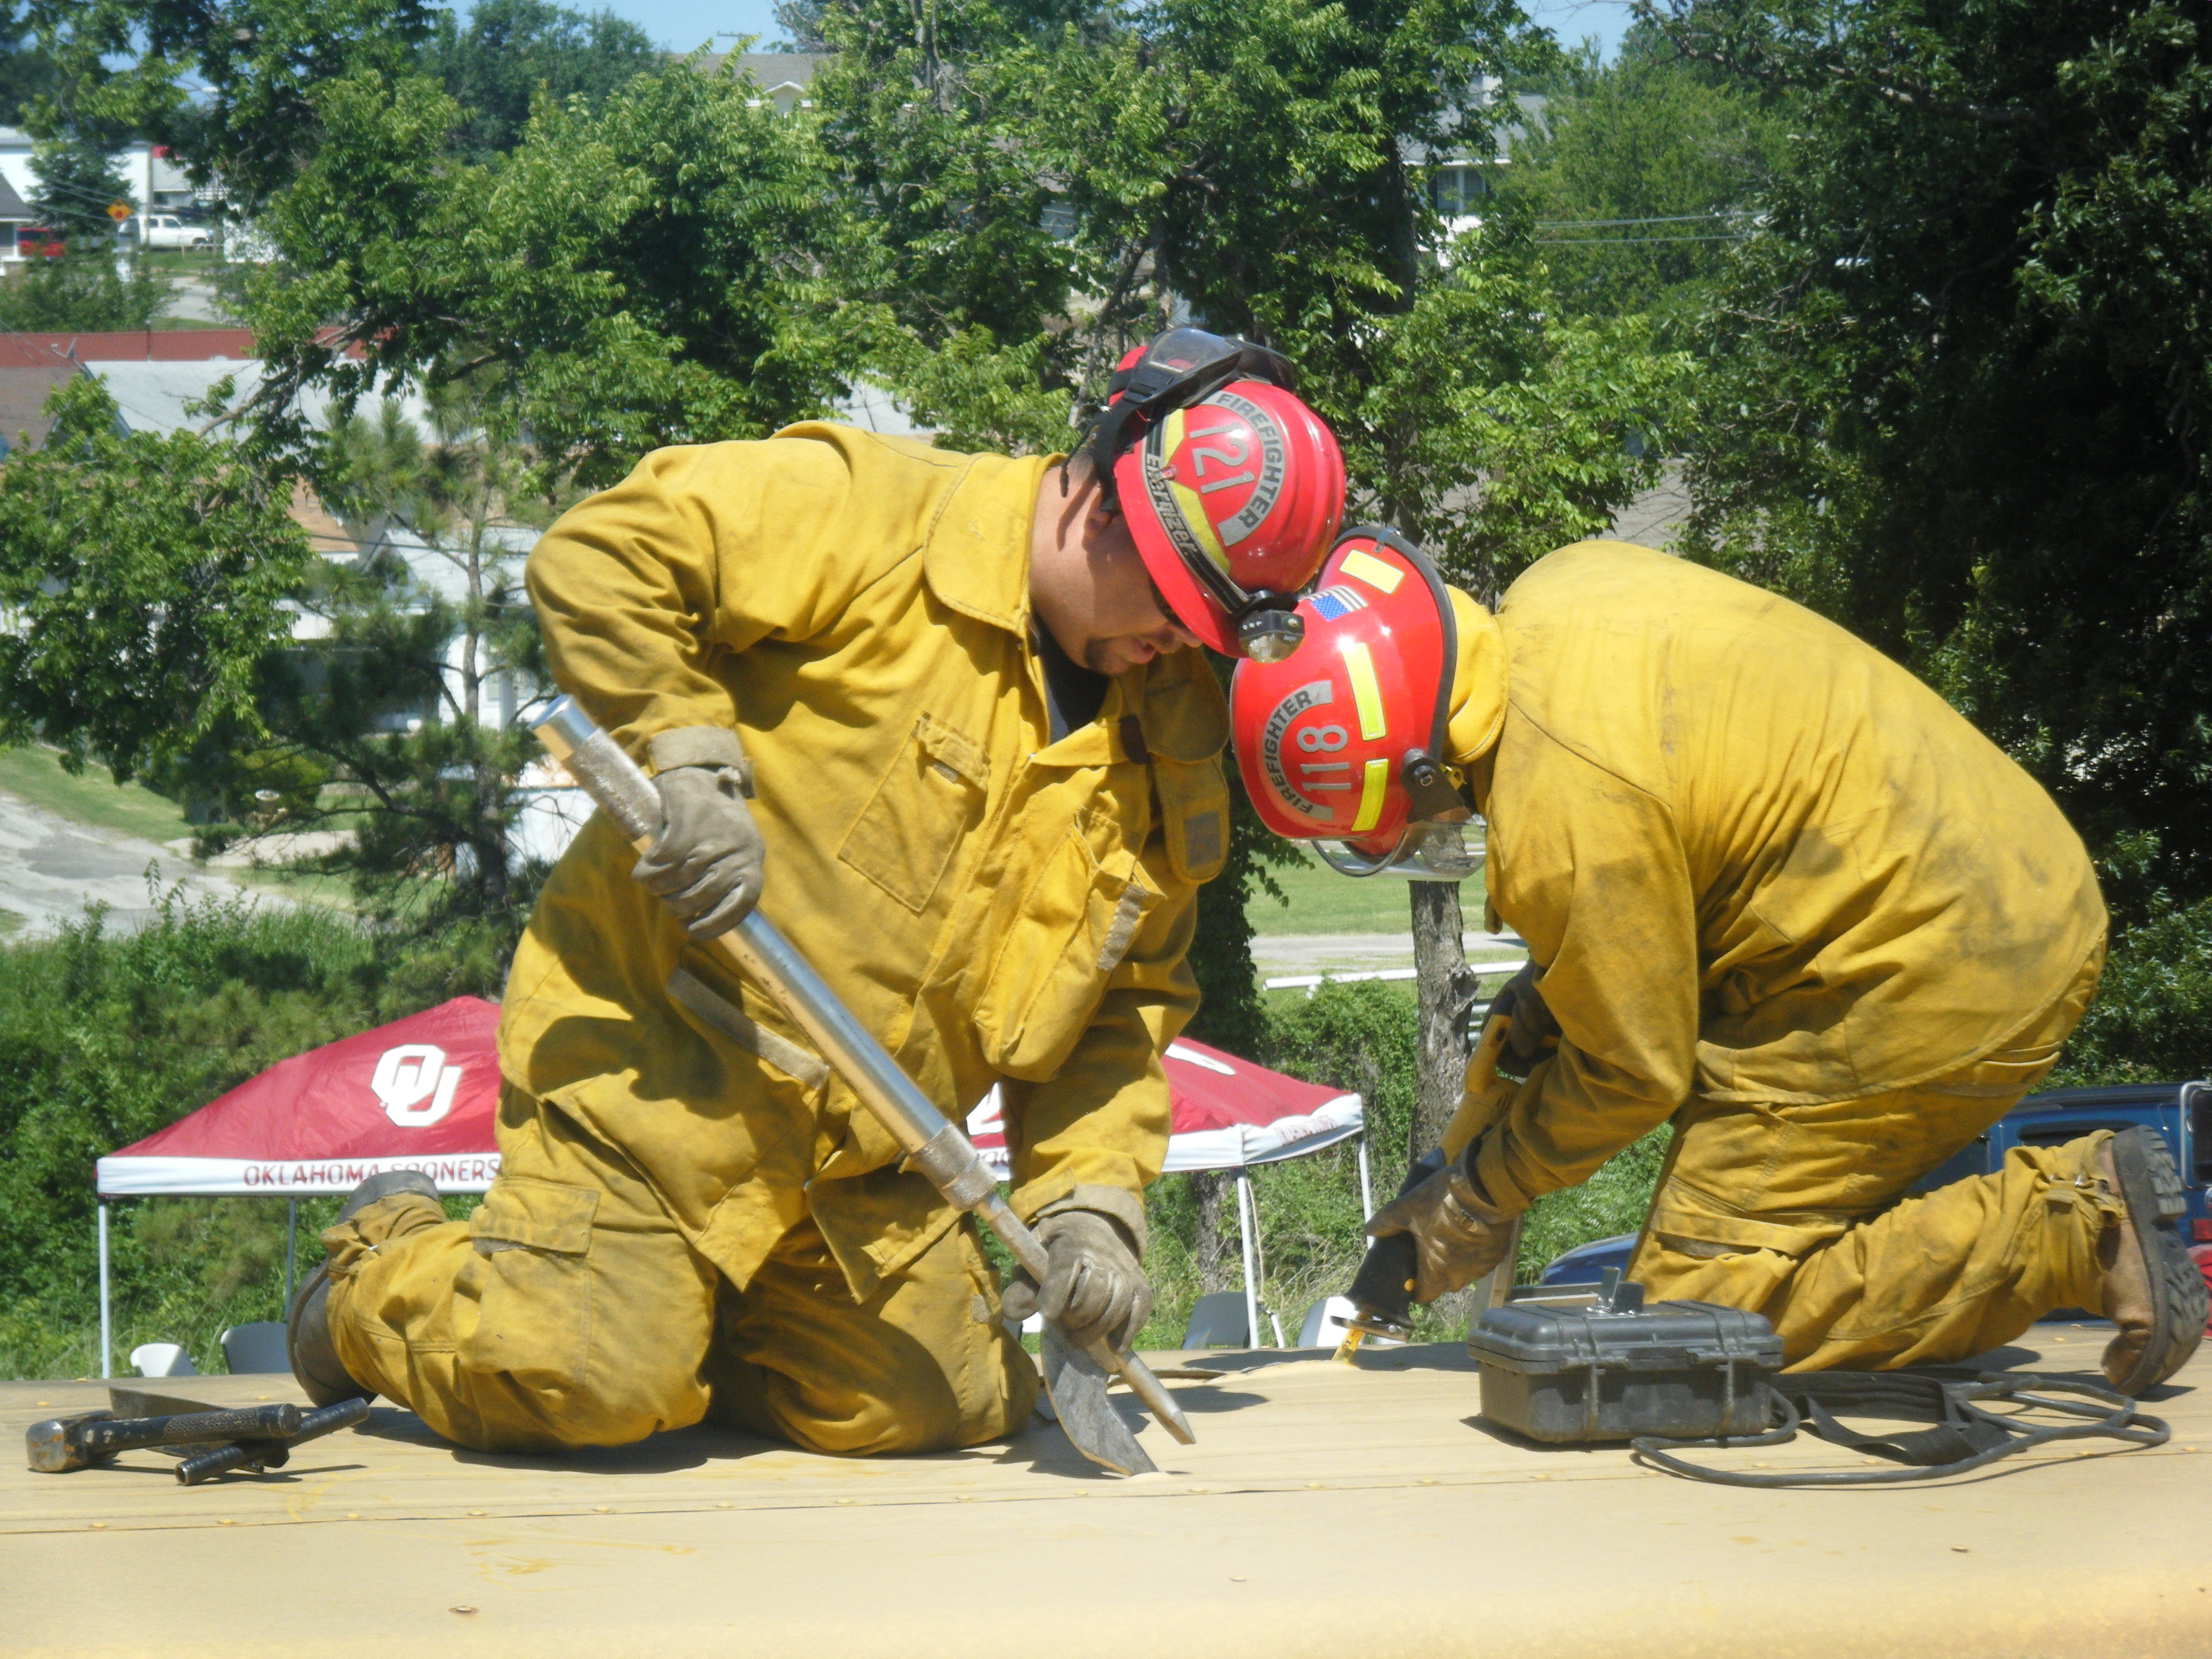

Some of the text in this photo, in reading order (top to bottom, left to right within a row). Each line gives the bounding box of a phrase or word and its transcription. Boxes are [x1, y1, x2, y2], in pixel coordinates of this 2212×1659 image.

[1189, 422, 1255, 494] 121
[1216, 393, 1282, 529] FIREFIGHTER
[1264, 690, 1314, 814] FIREFIGHTER
[1296, 725, 1352, 792] 118
[370, 1043, 463, 1127] OU
